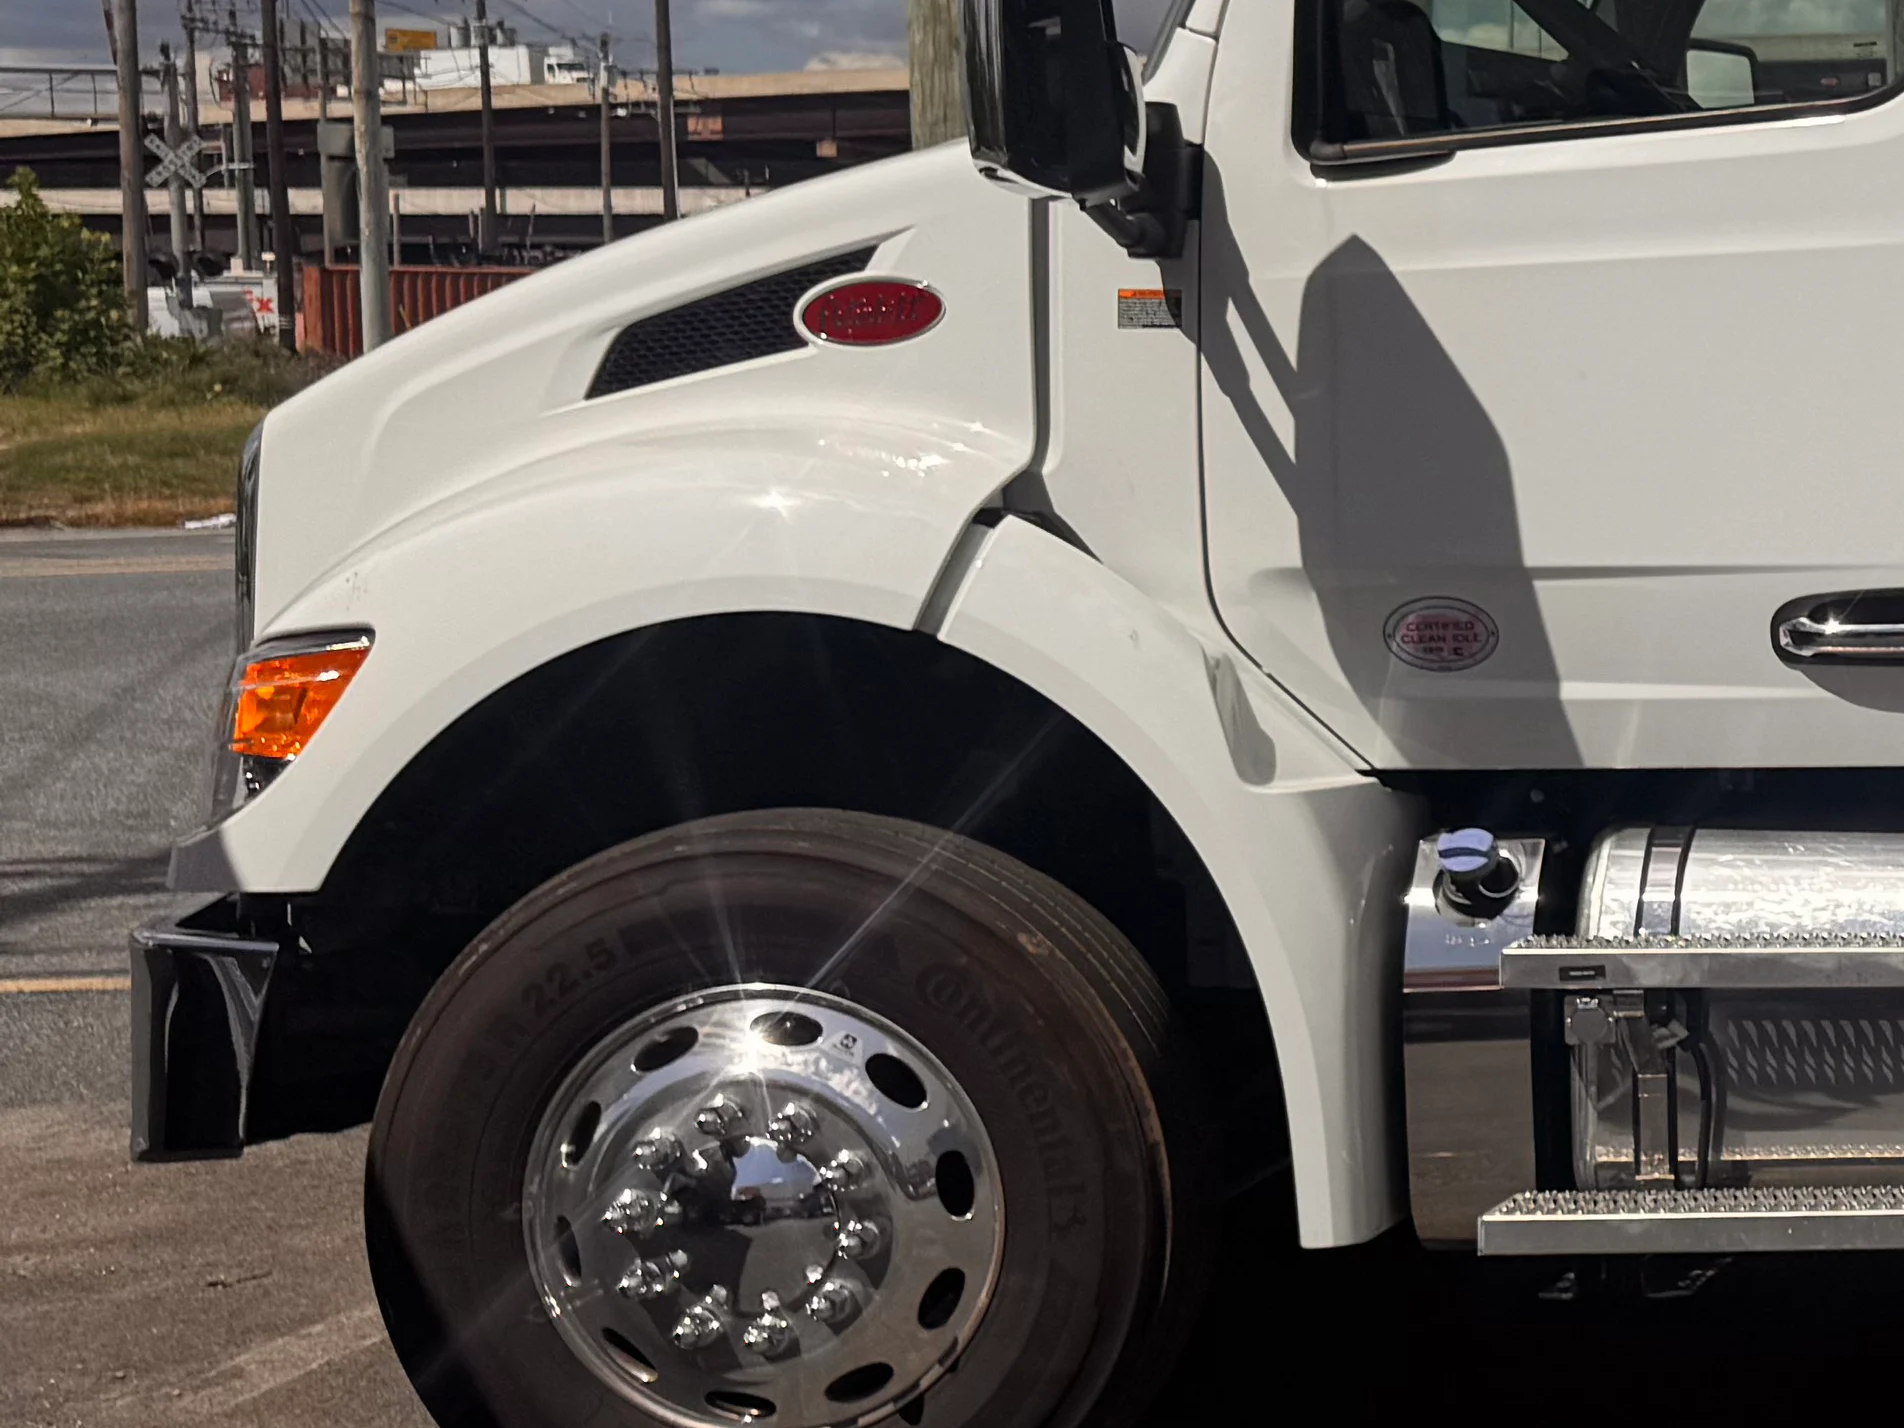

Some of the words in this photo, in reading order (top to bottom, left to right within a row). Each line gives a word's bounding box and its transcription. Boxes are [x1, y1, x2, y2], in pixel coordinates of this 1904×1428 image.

[1401, 633, 1447, 645] CLEAN
[519, 936, 617, 1019] 22.5
[917, 960, 1084, 1192] Continental
